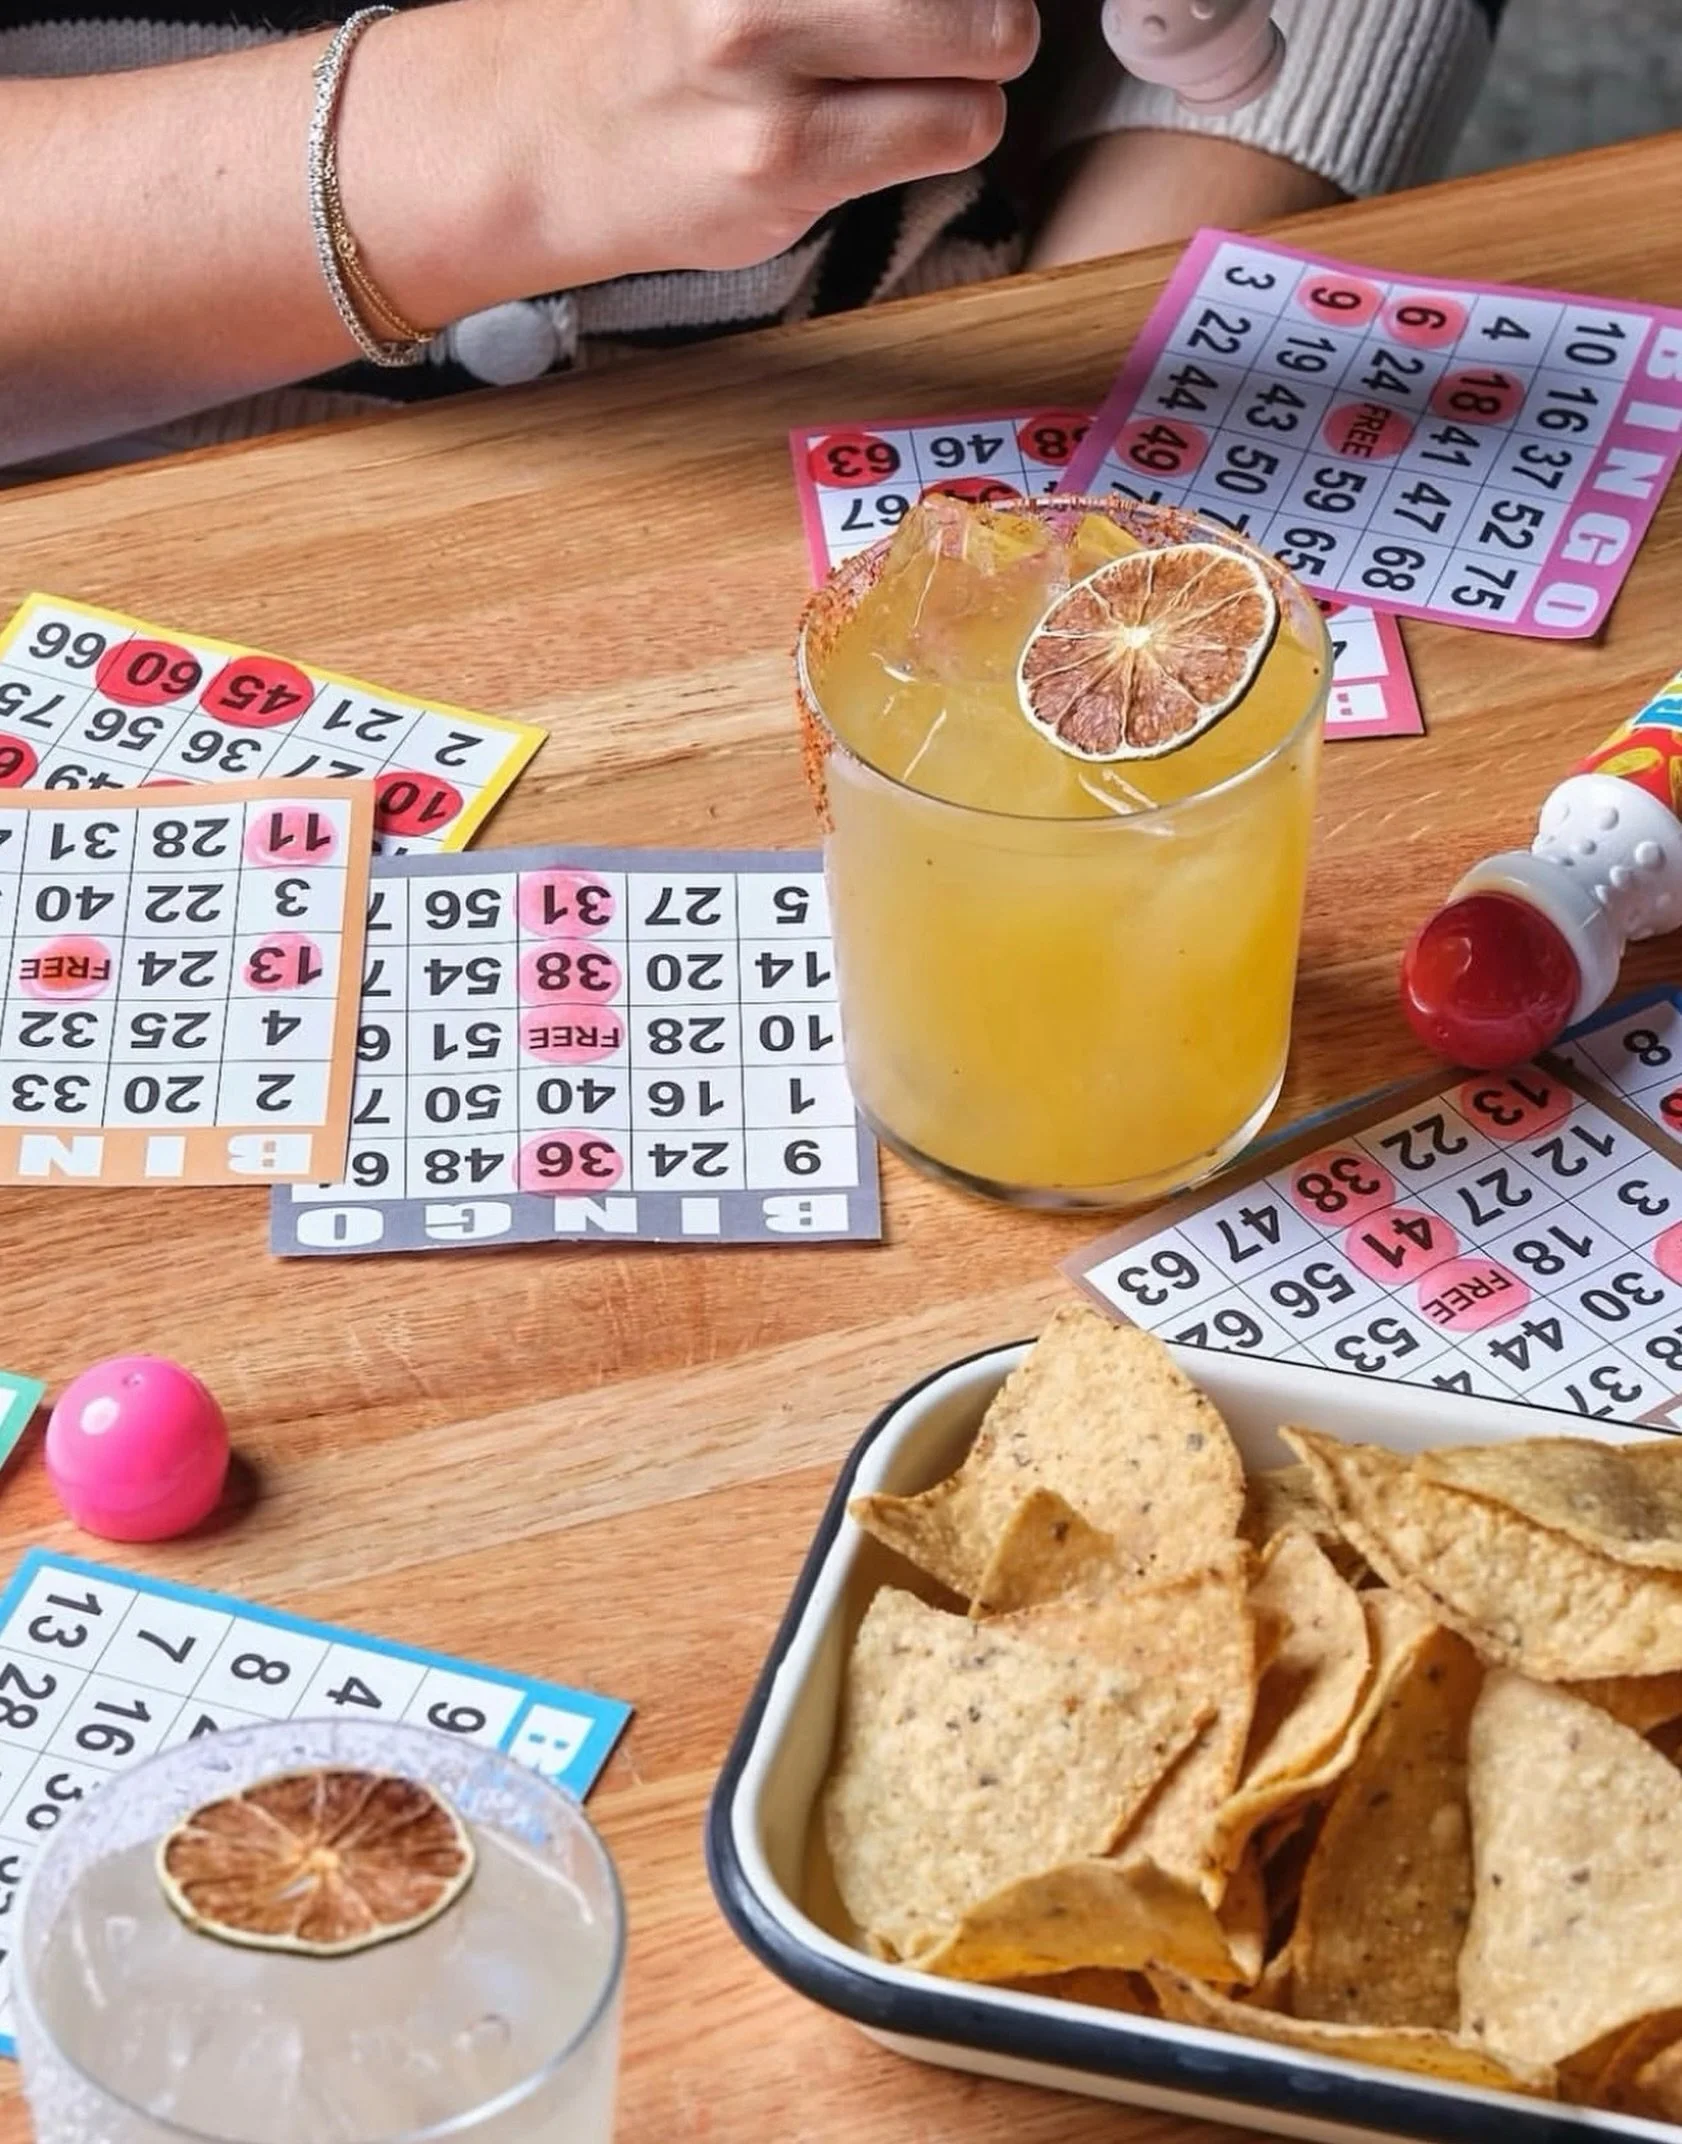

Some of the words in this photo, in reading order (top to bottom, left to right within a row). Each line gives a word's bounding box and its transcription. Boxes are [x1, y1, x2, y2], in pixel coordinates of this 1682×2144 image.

[1226, 267, 1275, 289] 3
[1187, 310, 1251, 354] 22
[1482, 317, 1530, 340] 4
[1565, 323, 1625, 365] 10
[1276, 338, 1336, 373] 19
[1361, 350, 1424, 395] 24
[1158, 365, 1219, 411] 44
[1246, 384, 1306, 431] 43
[1447, 374, 1510, 415] 18
[1340, 402, 1391, 457] FREE
[1536, 388, 1598, 432] 16
[828, 439, 901, 477] 63
[931, 434, 1004, 468] 46
[1130, 425, 1188, 470] 49
[1421, 425, 1480, 466] 41
[1216, 445, 1279, 494] 50
[1512, 444, 1572, 489] 37
[1304, 468, 1367, 513] 59
[1394, 482, 1451, 533] 47
[841, 494, 909, 531] 67
[1479, 501, 1544, 549] 52
[1275, 526, 1337, 577] 65
[1362, 546, 1425, 591] 68
[1451, 565, 1517, 610] 75
[29, 623, 106, 669] 66
[127, 652, 203, 695] 60
[219, 675, 301, 714] 45
[84, 708, 163, 751] 56
[323, 700, 403, 742] 21
[182, 730, 261, 772] 36
[435, 732, 483, 766] 2
[379, 781, 447, 823] 10
[50, 822, 119, 860] 31
[153, 818, 229, 858] 28
[270, 813, 331, 851] 11
[36, 886, 114, 922] 40
[145, 884, 224, 923] 22
[275, 879, 311, 917] 3
[426, 889, 501, 929] 56
[544, 885, 611, 925] 31
[645, 887, 721, 925] 27
[774, 887, 809, 924] 5
[20, 957, 111, 980] FREE
[138, 951, 217, 987] 24
[250, 946, 322, 985] 13
[424, 957, 501, 995] 54
[536, 952, 612, 991] 38
[647, 954, 723, 991] 20
[755, 952, 830, 988] 14
[19, 1011, 98, 1048] 32
[131, 1012, 211, 1048] 25
[262, 1010, 301, 1045] 4
[434, 1022, 501, 1060] 51
[529, 1026, 620, 1049] FREE
[648, 1017, 725, 1054] 28
[760, 1015, 833, 1051] 10
[12, 1074, 90, 1113] 33
[124, 1076, 204, 1114] 20
[256, 1074, 295, 1111] 2
[353, 1088, 391, 1124] 7
[425, 1084, 501, 1123] 50
[537, 1079, 616, 1114] 40
[648, 1081, 723, 1117] 16
[790, 1078, 815, 1114] 1
[1472, 1078, 1553, 1127] 13
[537, 1142, 615, 1177] 36
[648, 1142, 728, 1177] 24
[784, 1140, 821, 1175] 9
[1380, 1114, 1468, 1170] 22
[1531, 1126, 1615, 1176] 12
[352, 1150, 390, 1188] 6
[424, 1148, 504, 1184] 48
[1297, 1157, 1380, 1212] 38
[1457, 1168, 1532, 1227] 27
[1618, 1180, 1669, 1215] 3
[297, 1194, 849, 1247] BINGO
[1216, 1205, 1280, 1263] 47
[1362, 1217, 1433, 1268] 41
[1513, 1226, 1593, 1275] 18
[1118, 1251, 1199, 1305] 63
[1270, 1262, 1355, 1318] 56
[1422, 1269, 1513, 1324] FREE
[1580, 1272, 1664, 1321] 30
[1335, 1318, 1420, 1372] 53
[1488, 1317, 1563, 1371] 44
[29, 1593, 102, 1648] 13
[137, 1630, 196, 1663] 7
[231, 1654, 290, 1684] 8
[327, 1677, 382, 1709] 4
[76, 1700, 151, 1755] 16
[428, 1702, 486, 1733] 9
